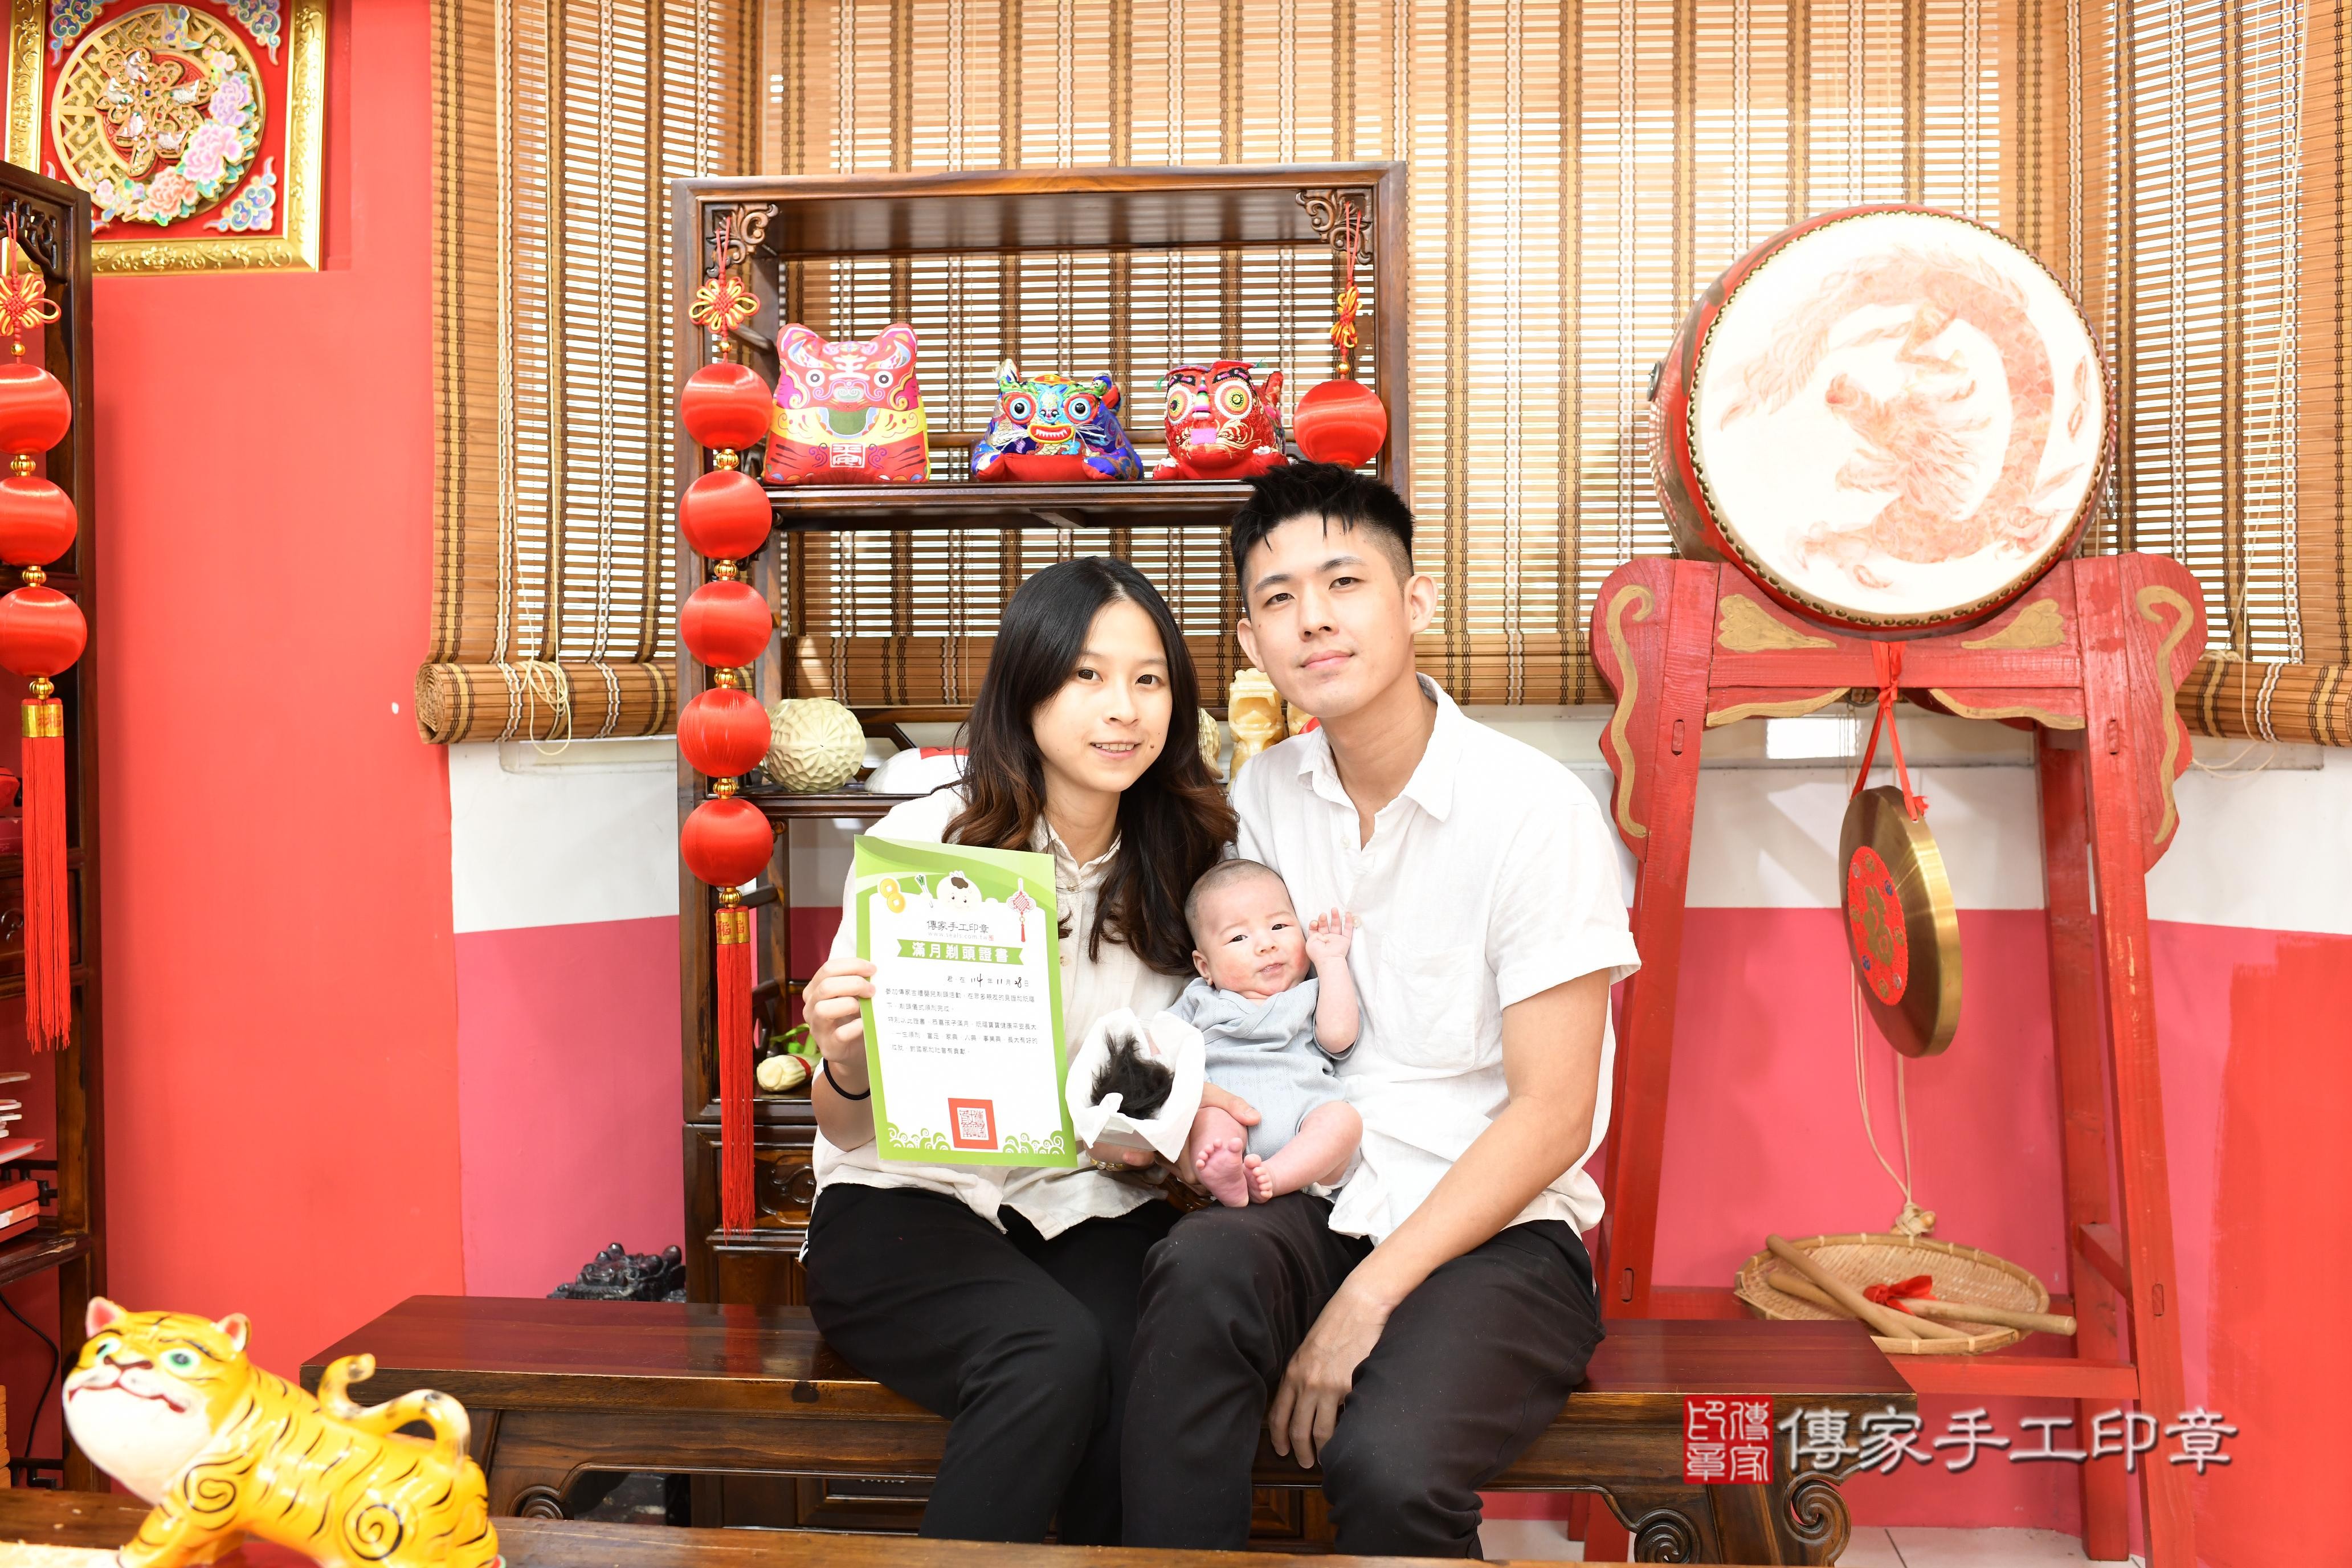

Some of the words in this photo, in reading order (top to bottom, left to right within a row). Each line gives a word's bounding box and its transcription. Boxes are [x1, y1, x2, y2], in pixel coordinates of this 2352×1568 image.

[926, 920, 989, 933] 傳家手工印章
[912, 941, 1008, 962] 滿月剃頭證書
[970, 973, 983, 988] 114
